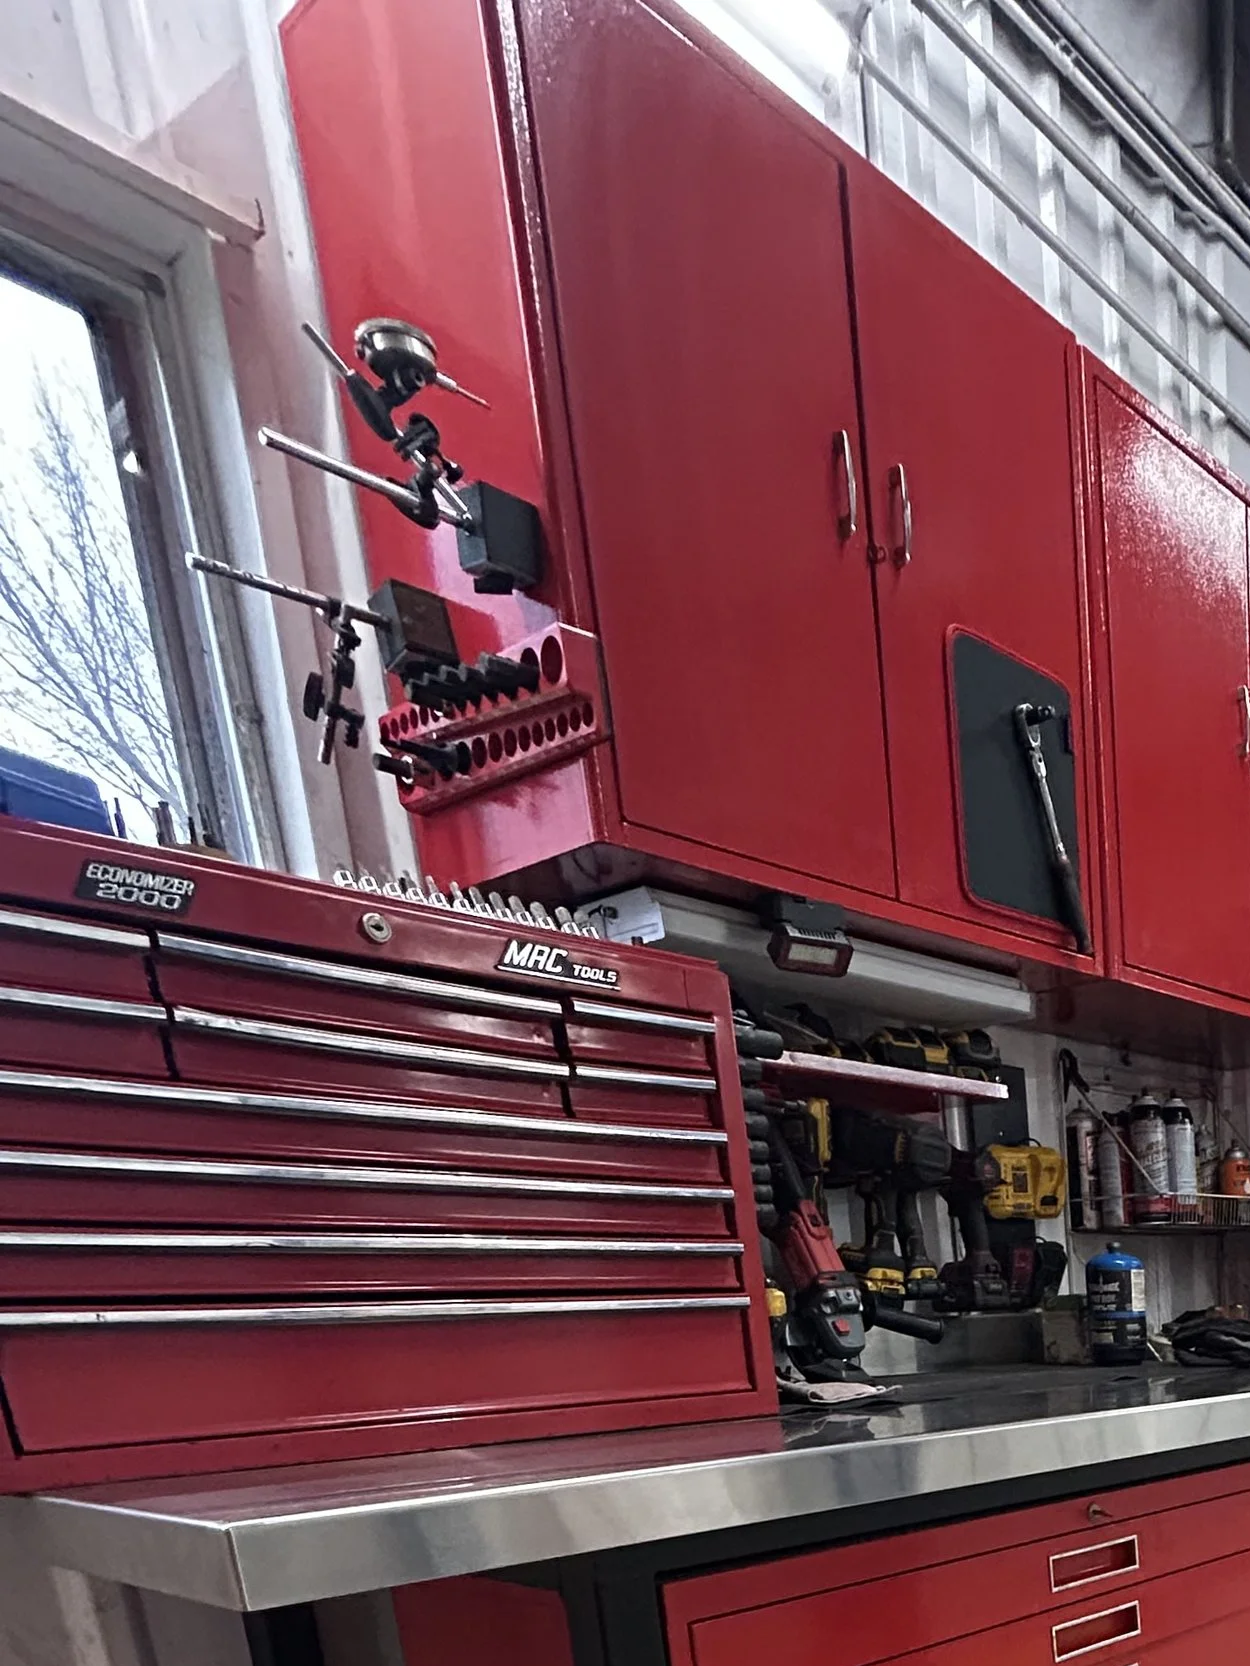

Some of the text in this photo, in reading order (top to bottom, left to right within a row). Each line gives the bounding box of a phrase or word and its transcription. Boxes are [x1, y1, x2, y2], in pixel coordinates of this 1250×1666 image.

[86, 863, 195, 896] ECONOMIZER
[96, 882, 182, 909] 2000
[503, 940, 617, 982] MAC TOOLS
